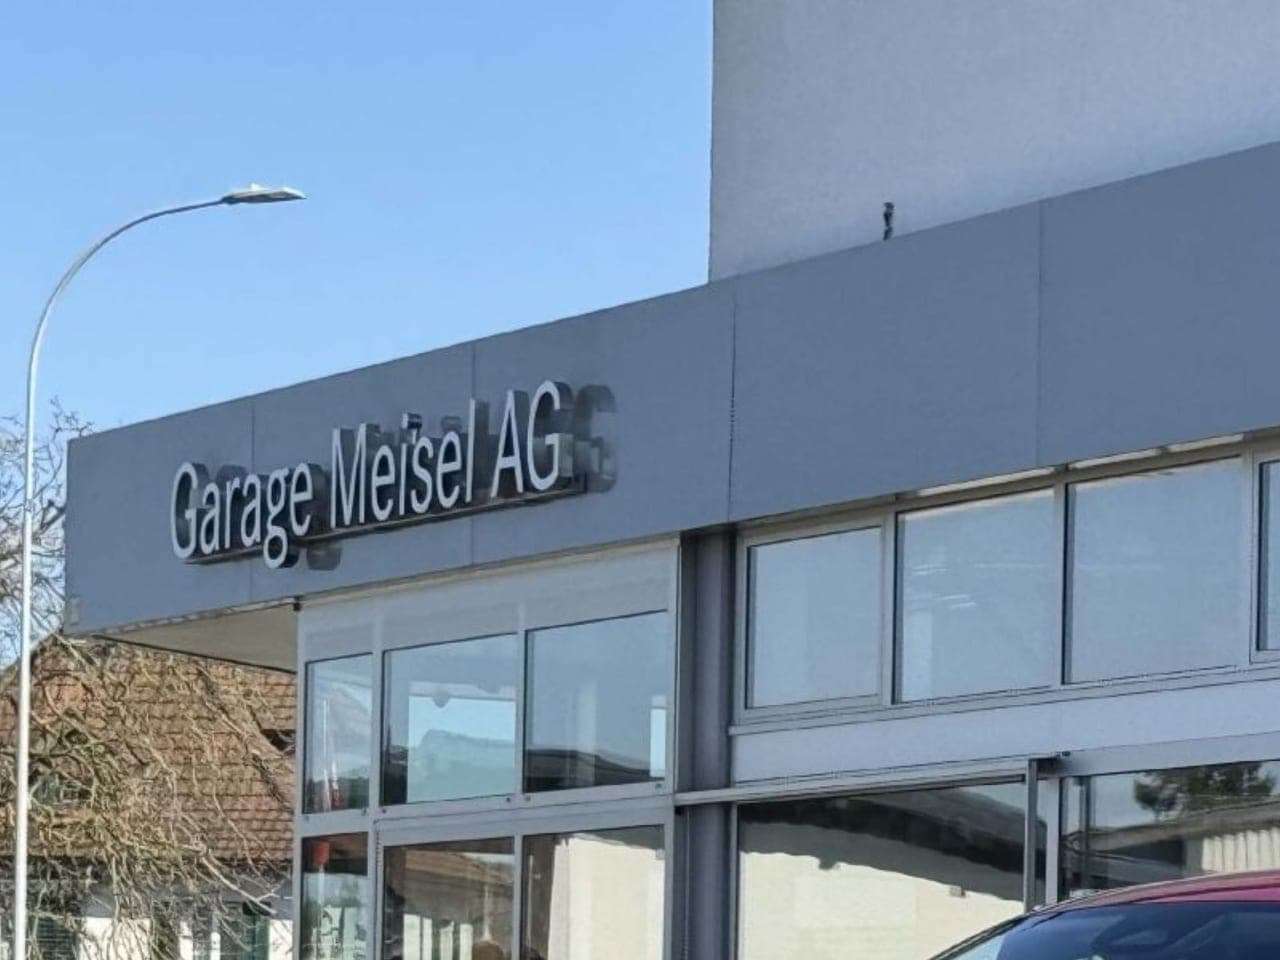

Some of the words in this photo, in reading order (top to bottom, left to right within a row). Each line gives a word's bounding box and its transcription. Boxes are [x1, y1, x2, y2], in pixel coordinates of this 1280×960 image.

[170, 461, 314, 570] Garage
[330, 398, 479, 529] Meisel
[489, 379, 562, 498] AG
